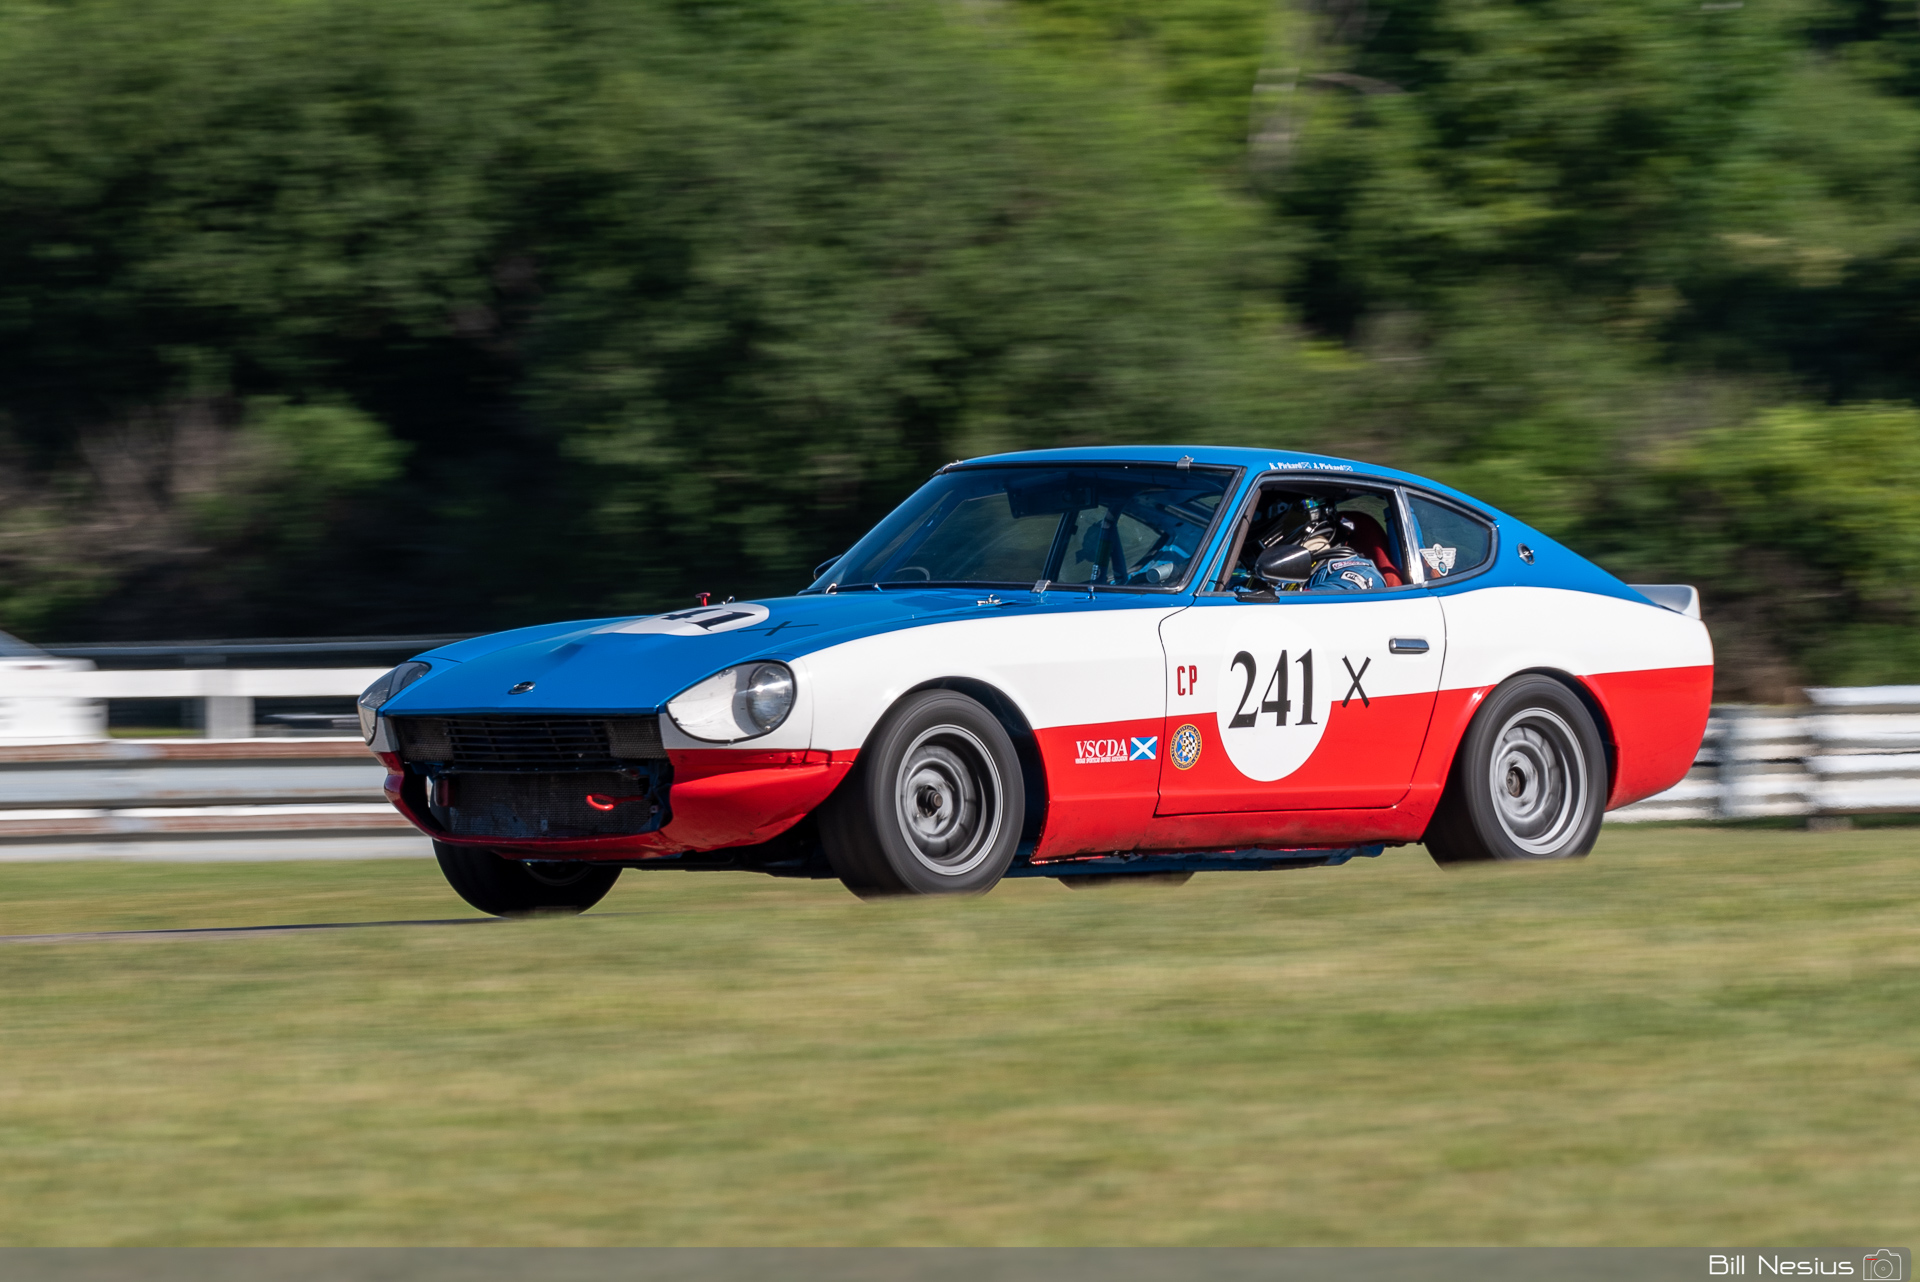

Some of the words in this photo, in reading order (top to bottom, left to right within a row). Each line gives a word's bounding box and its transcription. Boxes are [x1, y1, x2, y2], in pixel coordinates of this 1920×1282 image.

[1177, 665, 1198, 696] CP
[1228, 648, 1318, 729] 241
[1341, 655, 1372, 708] X
[1075, 738, 1128, 758] VSCDA
